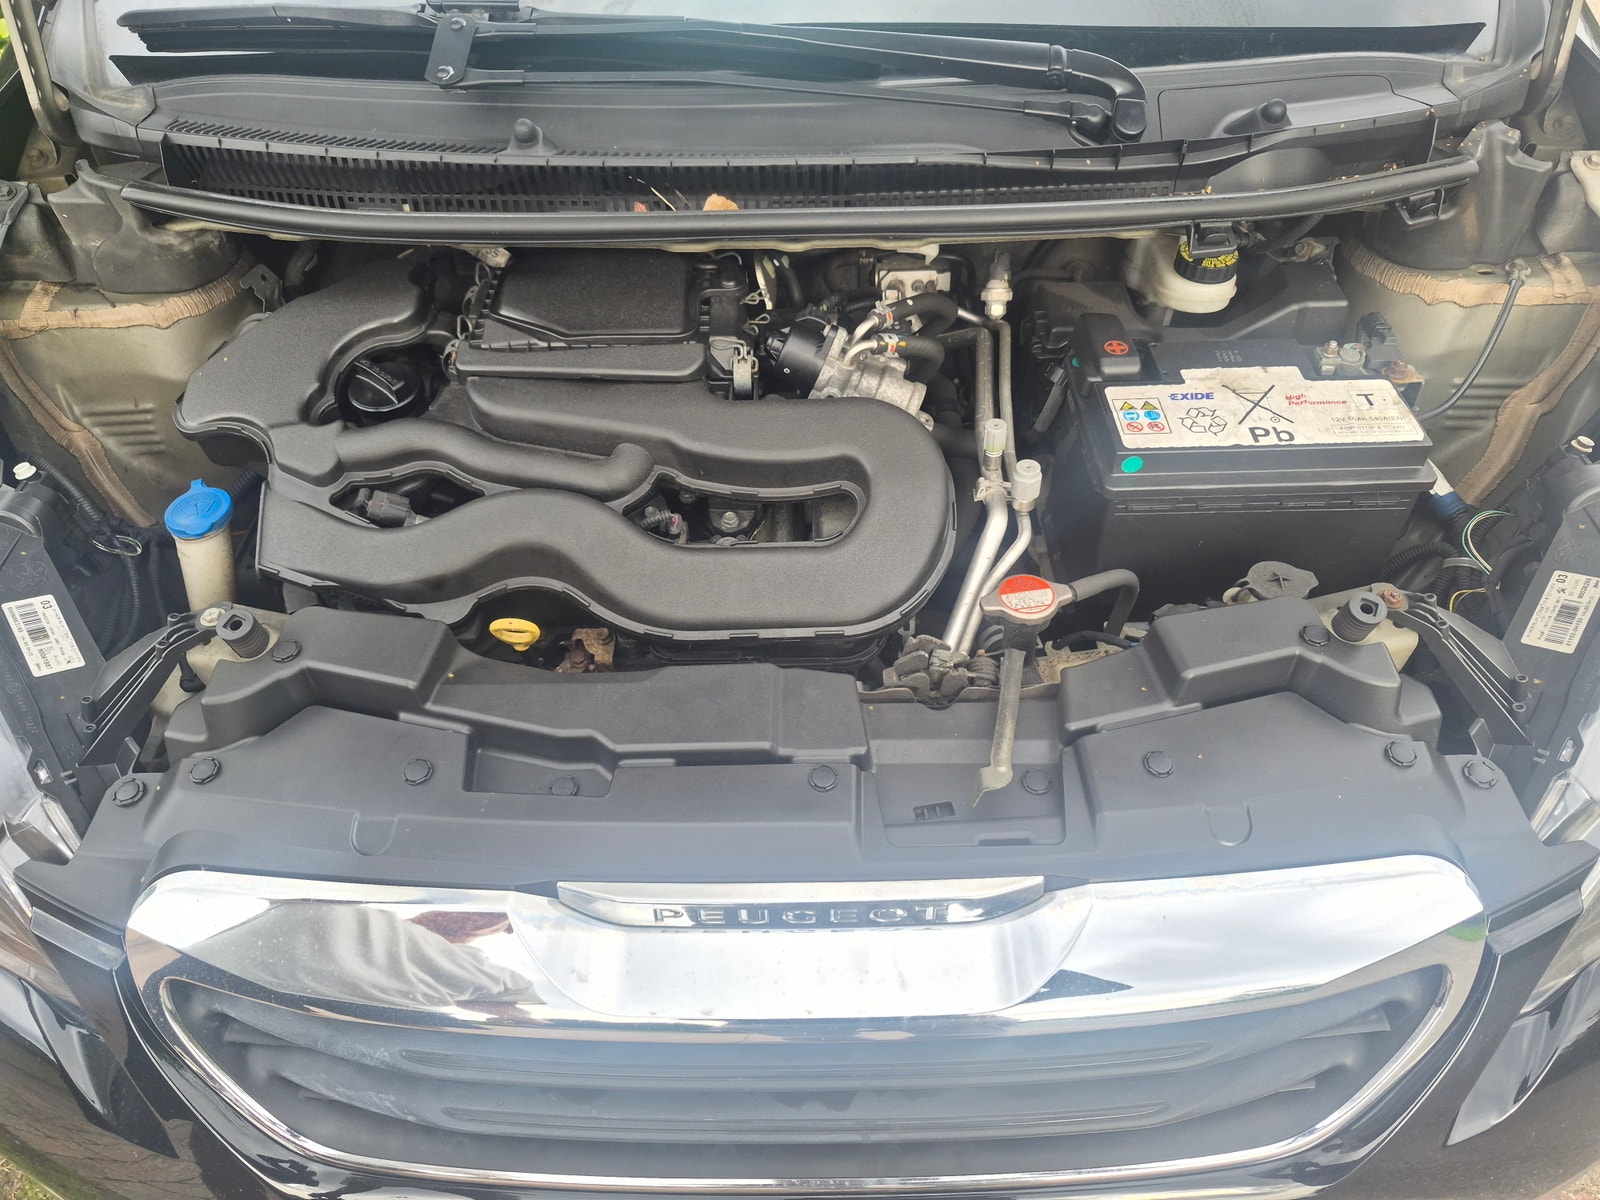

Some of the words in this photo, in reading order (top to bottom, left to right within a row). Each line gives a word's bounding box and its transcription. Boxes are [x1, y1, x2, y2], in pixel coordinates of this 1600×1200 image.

[1169, 392, 1215, 401] EXIDE
[1356, 393, 1375, 407] T
[1247, 426, 1296, 443] Pb
[1556, 574, 1568, 583] 03
[40, 600, 52, 610] 03
[652, 904, 950, 924] PEUGEOT
